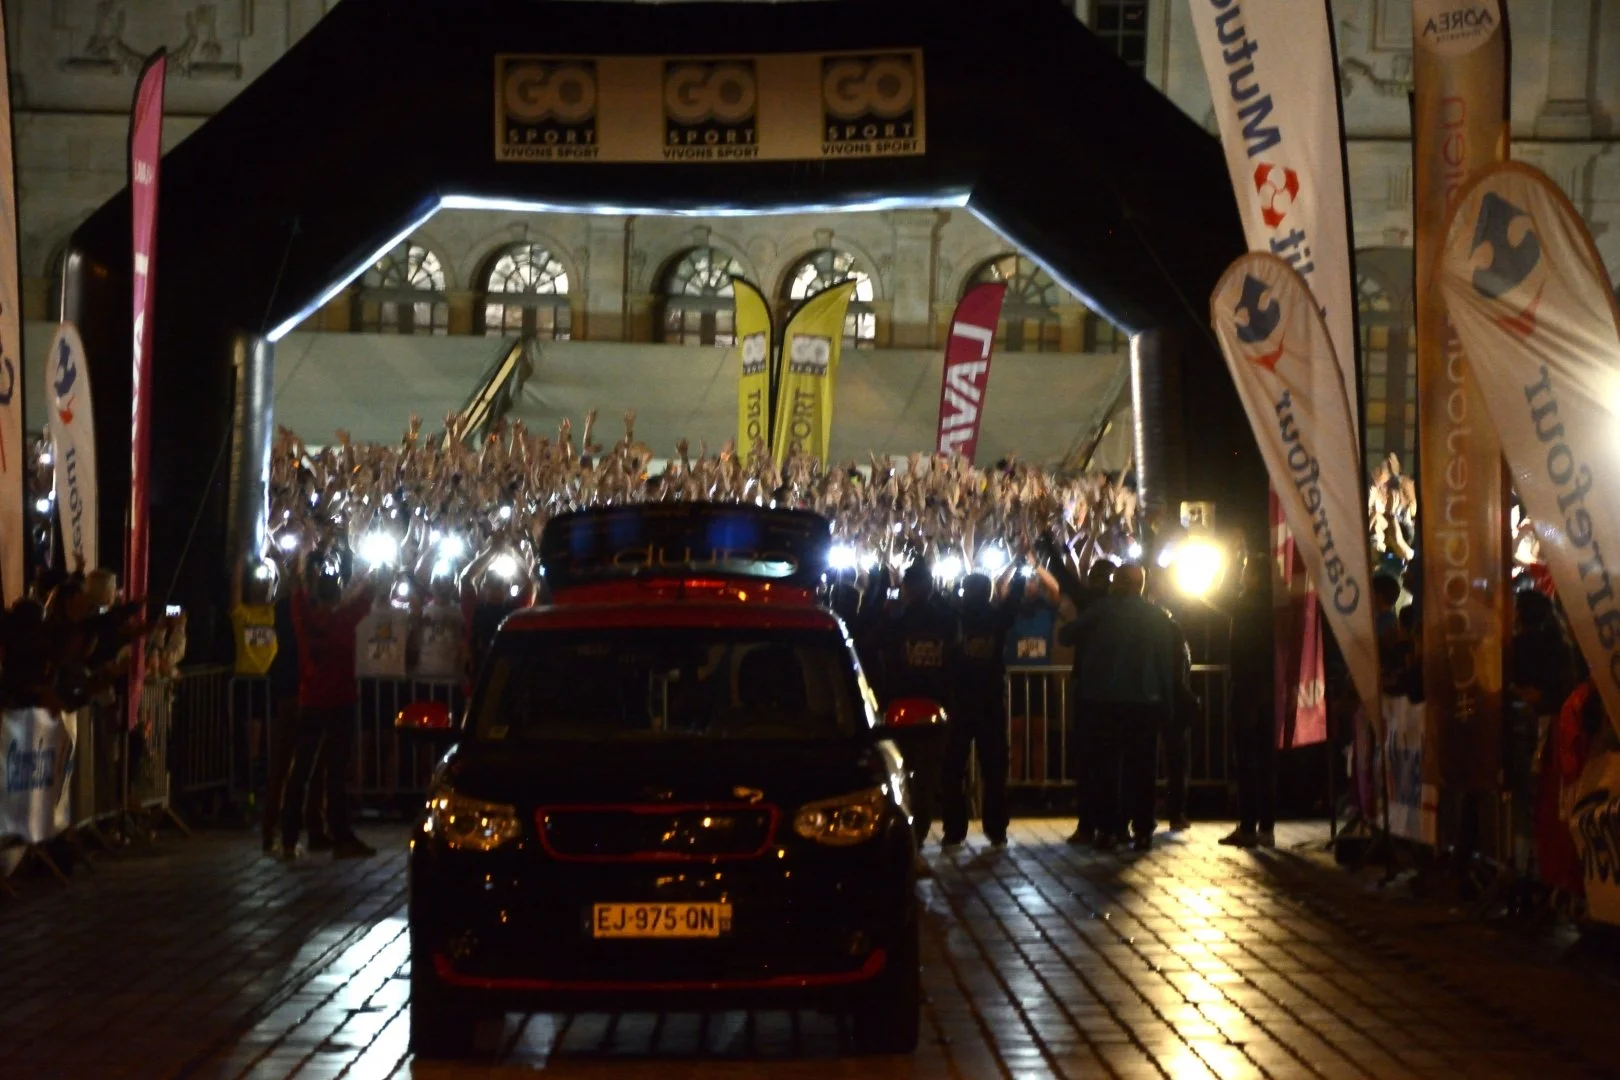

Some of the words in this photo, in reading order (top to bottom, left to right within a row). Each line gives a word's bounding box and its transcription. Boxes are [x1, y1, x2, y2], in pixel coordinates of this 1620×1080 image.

[503, 62, 597, 122] GO
[664, 66, 757, 124] GO
[824, 59, 914, 119] GO
[508, 128, 595, 144] SPORT
[669, 128, 753, 144] SPORT
[828, 122, 912, 140] SPORT
[557, 147, 599, 158] SPORT
[718, 147, 758, 158] SPORT
[822, 143, 871, 155] VIVONS
[876, 140, 918, 154] SPORT
